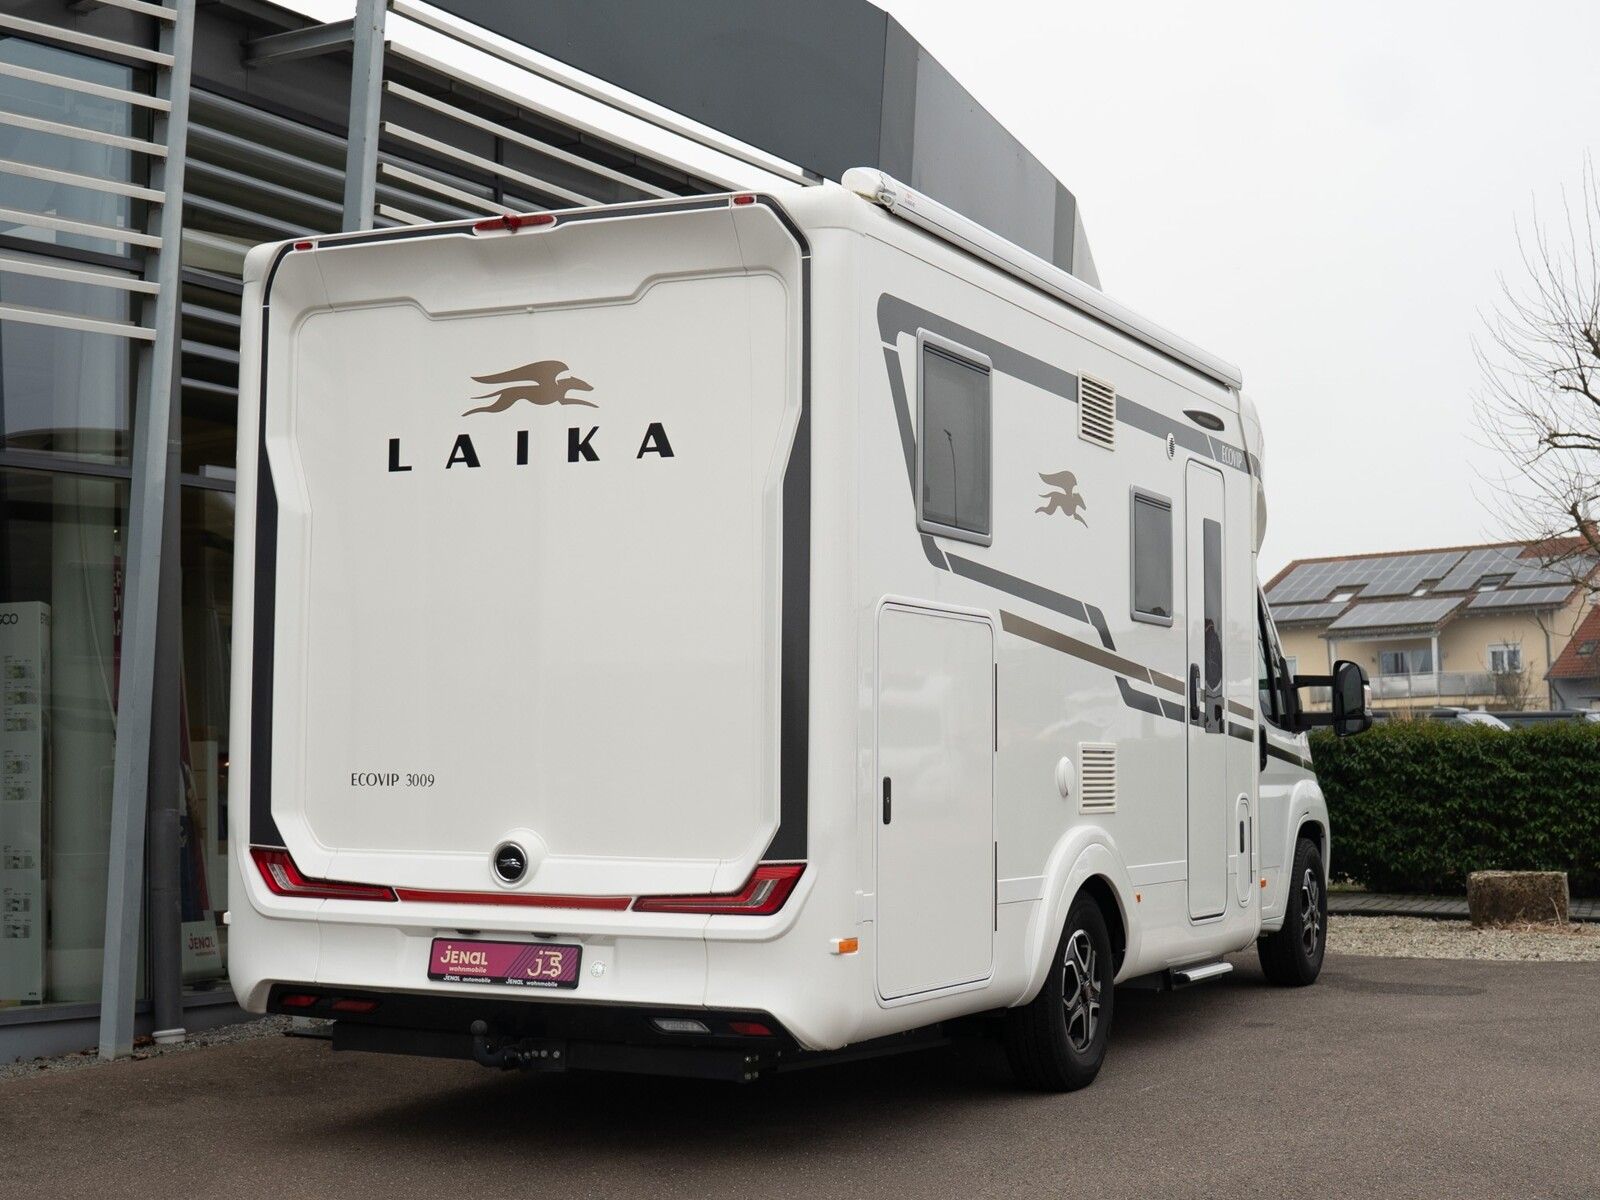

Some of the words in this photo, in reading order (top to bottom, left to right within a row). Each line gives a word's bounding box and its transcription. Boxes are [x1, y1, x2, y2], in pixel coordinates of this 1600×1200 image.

[388, 422, 675, 472] LAIKA
[1221, 445, 1243, 468] ECOVIP
[351, 772, 400, 787] ECOVIP
[405, 773, 435, 788] 3009
[449, 965, 487, 974] wohnmobile
[462, 976, 492, 984] automobile
[526, 980, 558, 988] wohnmobile
